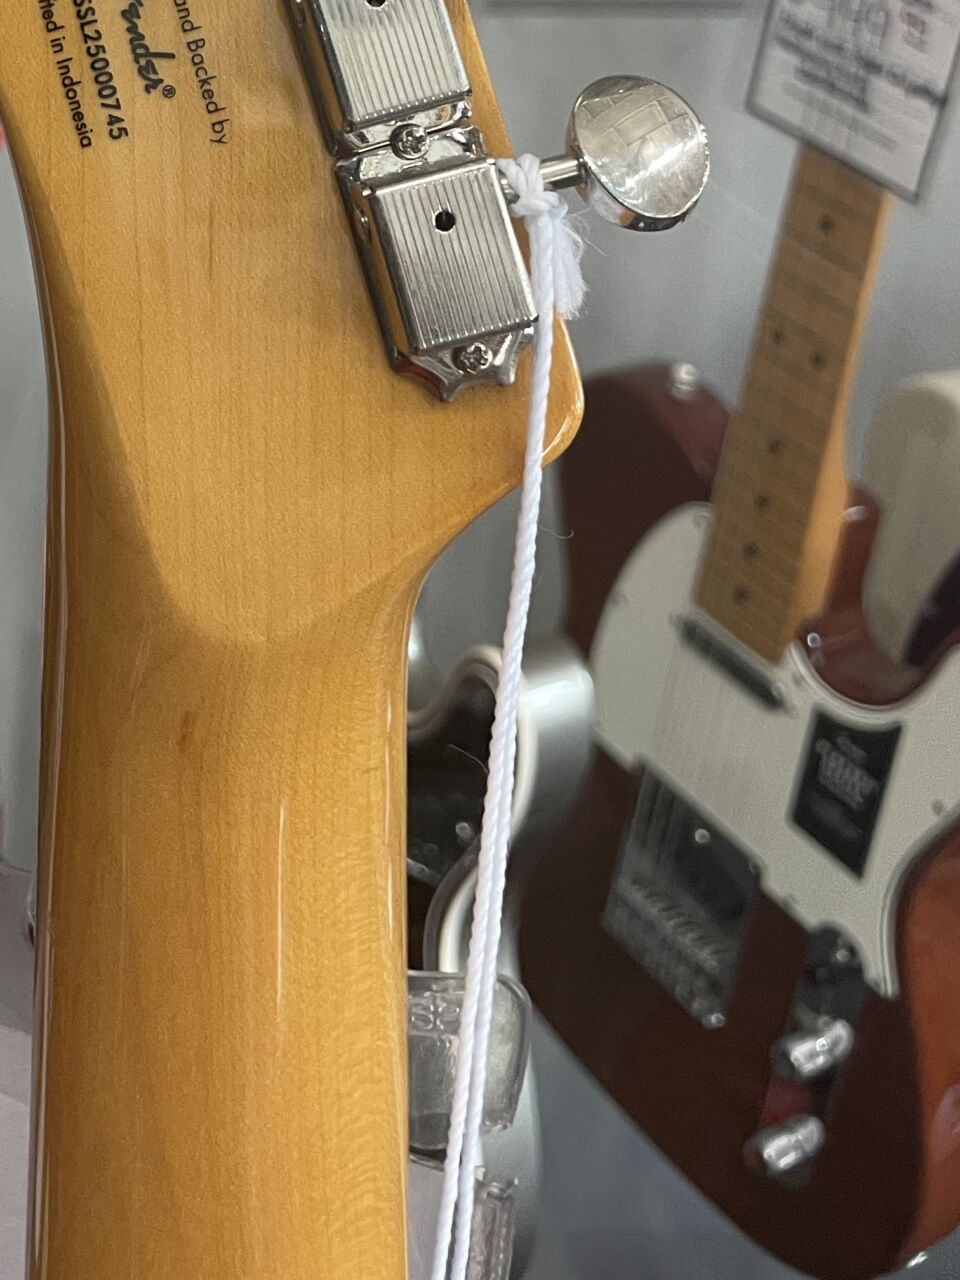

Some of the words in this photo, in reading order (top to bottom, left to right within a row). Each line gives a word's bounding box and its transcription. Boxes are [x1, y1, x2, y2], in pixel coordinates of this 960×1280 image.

[50, 35, 66, 54] in
[57, 57, 94, 149] Indonesia
[187, 37, 227, 114] Backed
[210, 119, 230, 145] by
